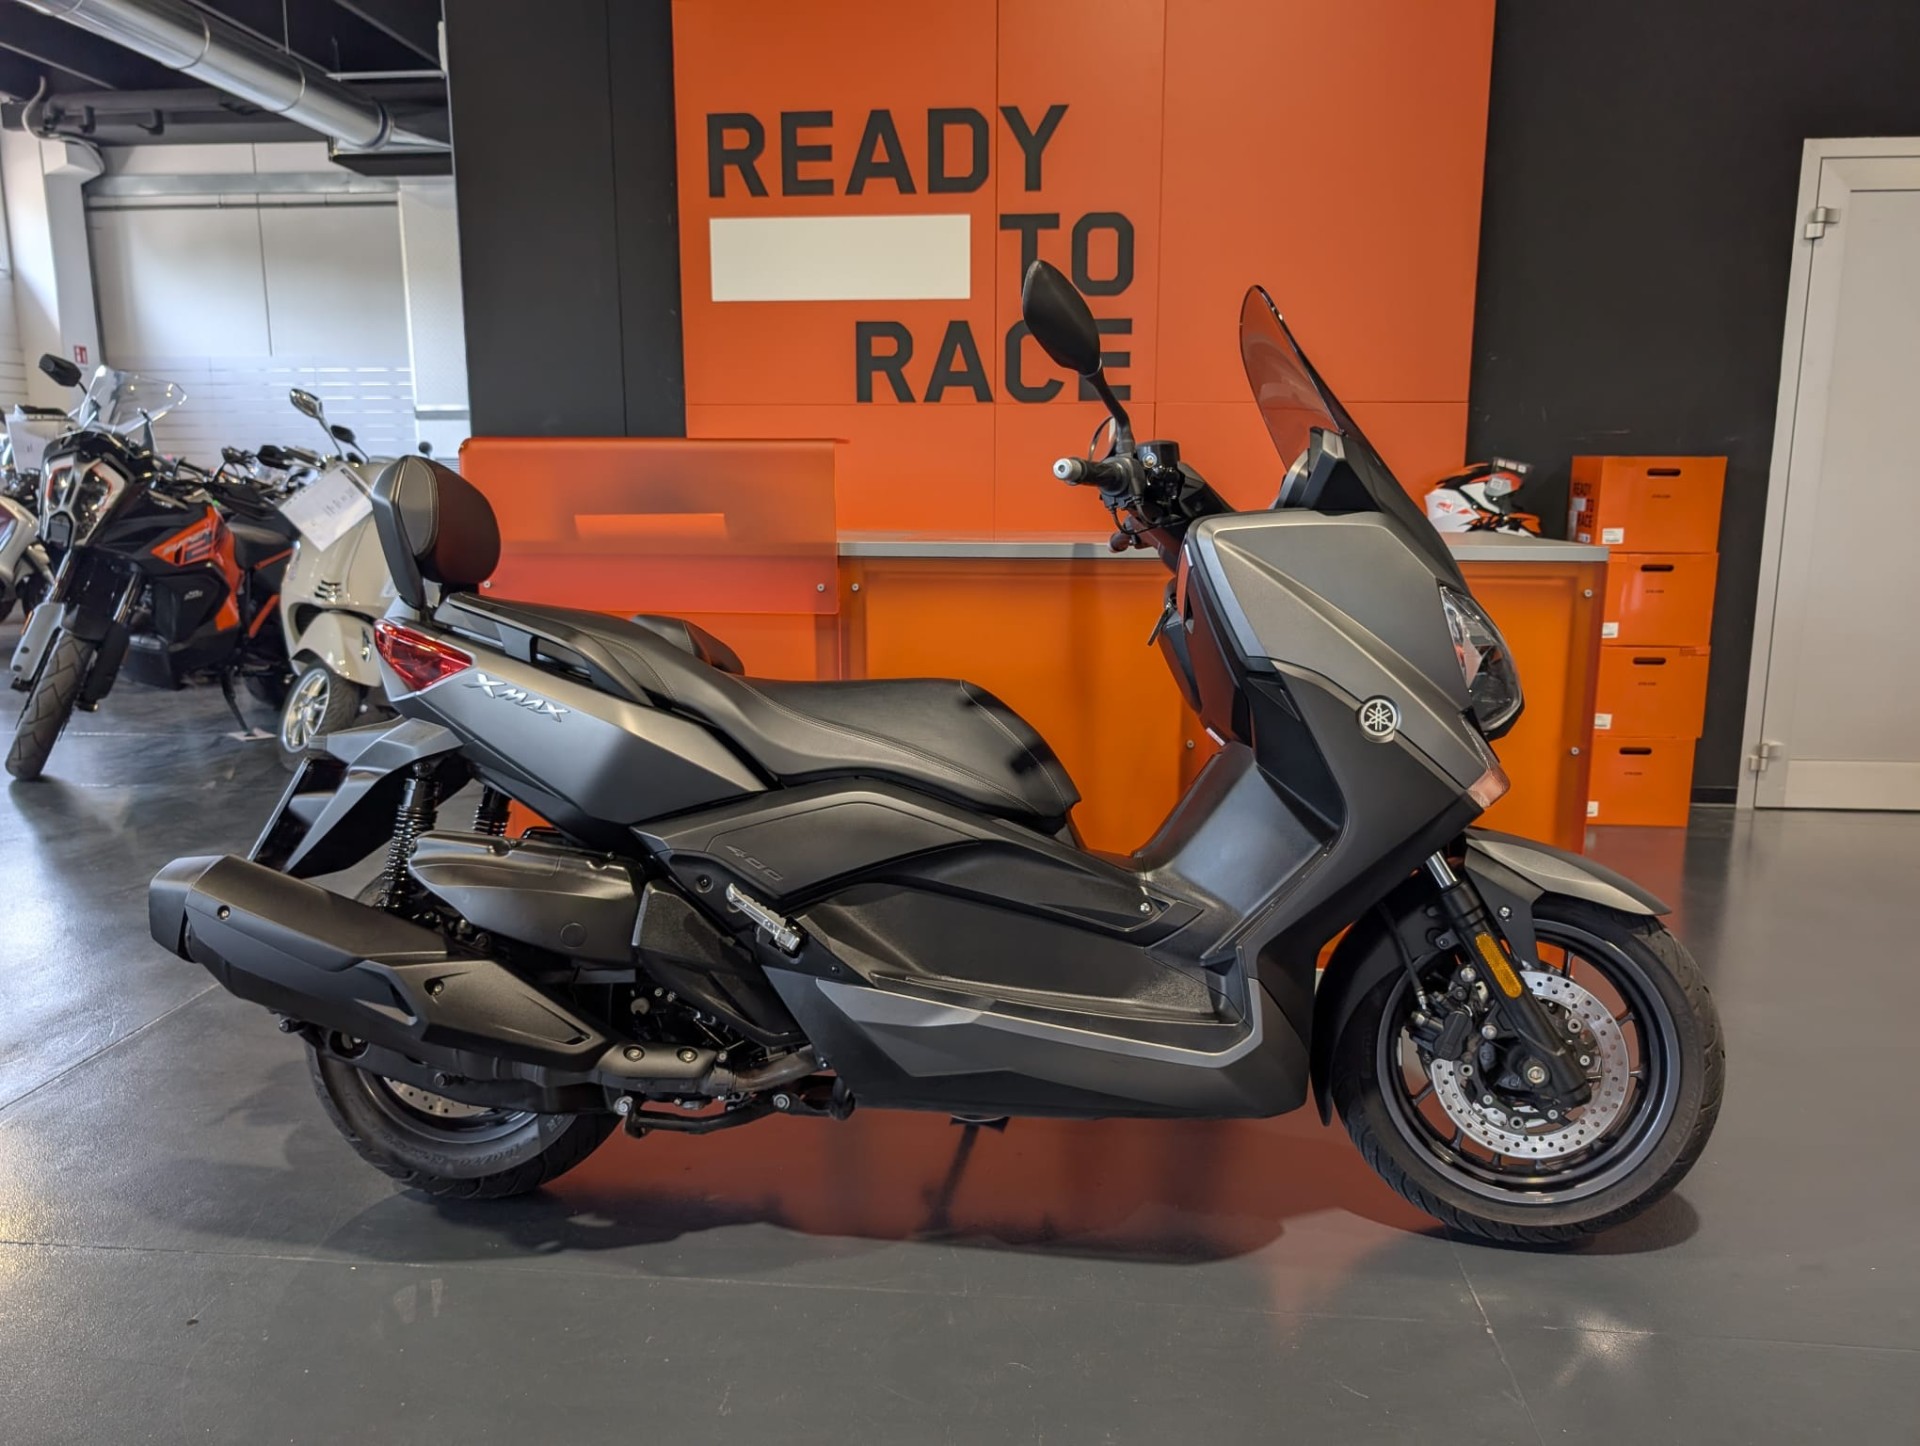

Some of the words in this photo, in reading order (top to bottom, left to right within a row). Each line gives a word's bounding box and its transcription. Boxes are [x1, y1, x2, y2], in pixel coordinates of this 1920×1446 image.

[706, 104, 1069, 198] READY
[999, 212, 1135, 297] TO
[855, 318, 1133, 404] RACE
[725, 844, 784, 881] 400
